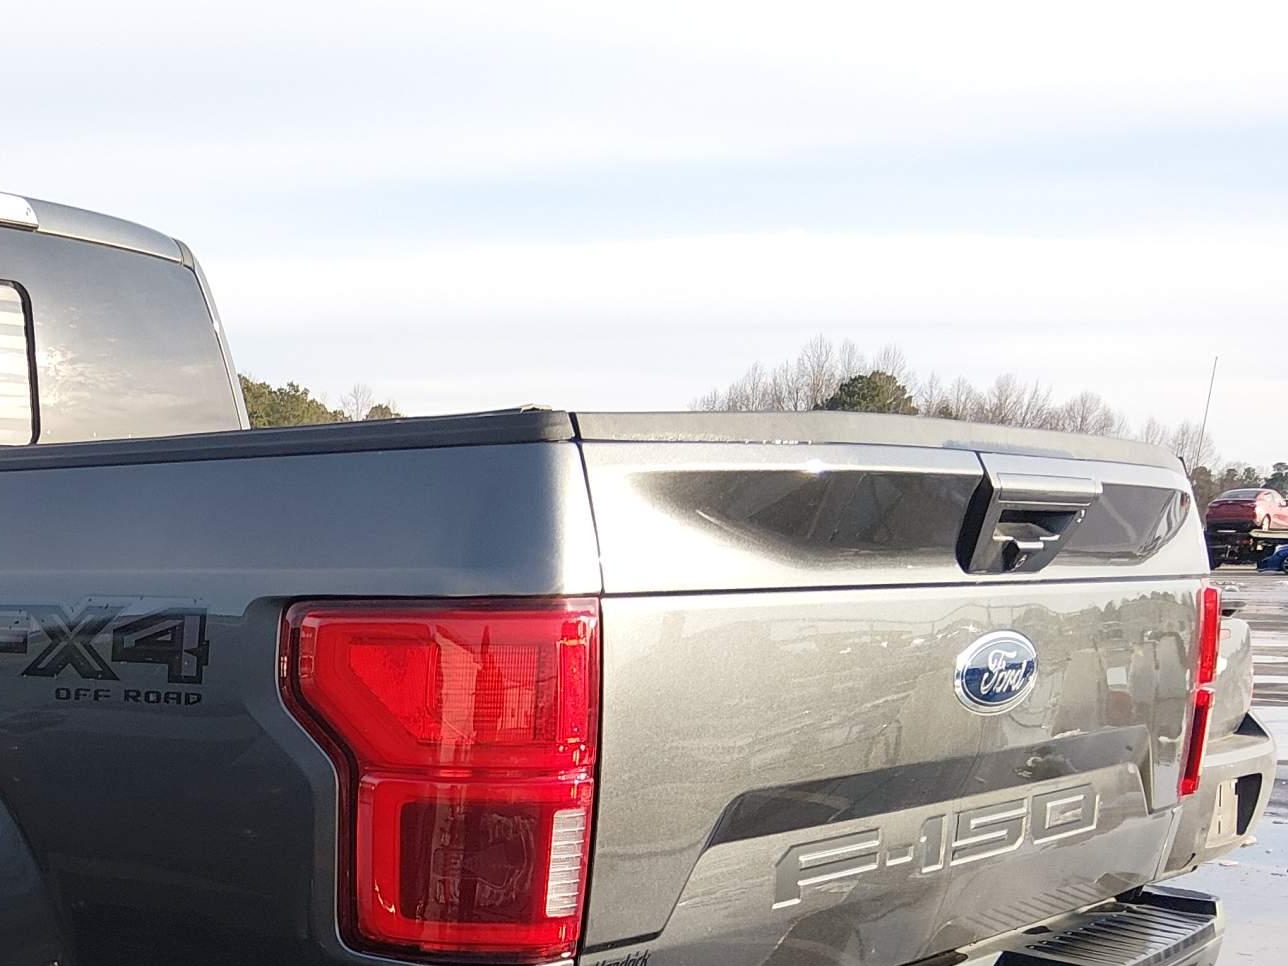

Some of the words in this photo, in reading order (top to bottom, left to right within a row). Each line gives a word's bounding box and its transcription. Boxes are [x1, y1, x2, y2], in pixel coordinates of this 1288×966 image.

[980, 649, 1027, 695] Ford
[55, 687, 111, 701] OFF
[123, 689, 203, 706] ROAD
[772, 783, 1099, 909] F-150
